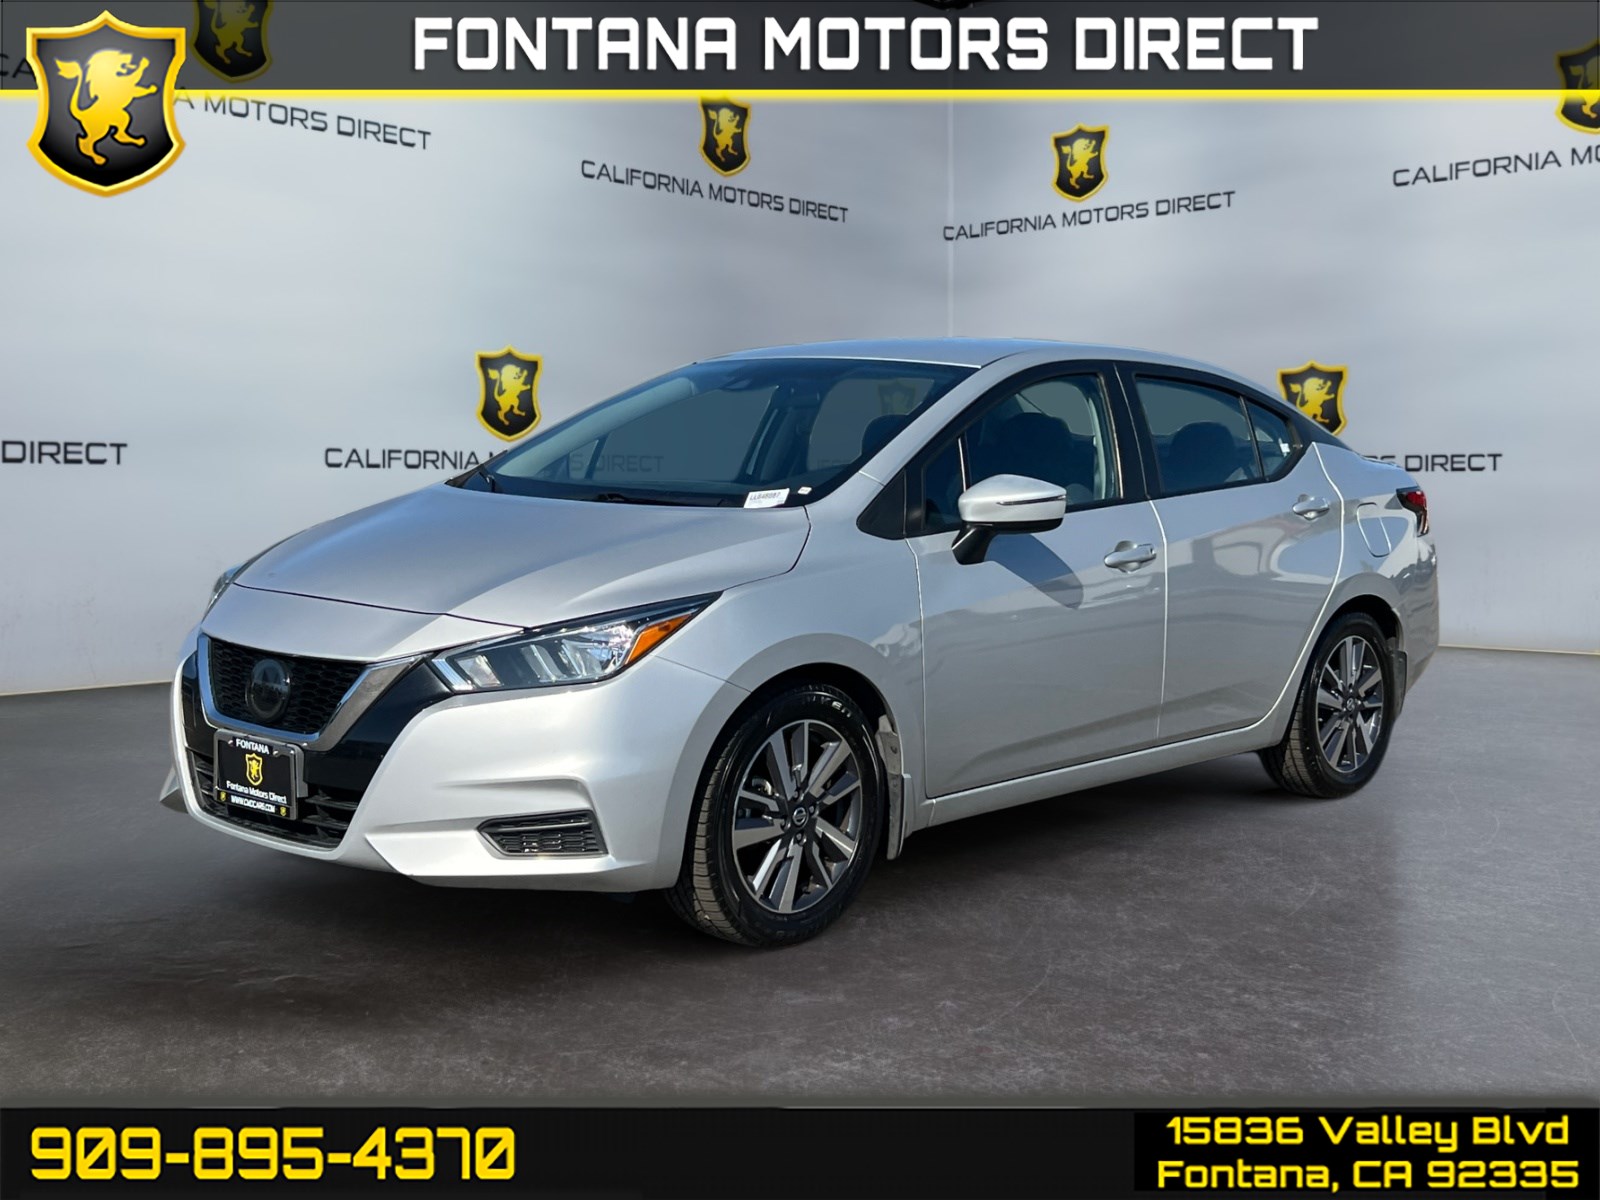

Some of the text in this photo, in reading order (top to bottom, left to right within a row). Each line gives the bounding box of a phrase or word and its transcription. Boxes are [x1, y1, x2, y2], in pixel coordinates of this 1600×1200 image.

[204, 90, 328, 132] MOTORS
[336, 115, 432, 150] DIRECT
[1392, 150, 1562, 188] CALIFORNIA
[581, 159, 849, 224] CALIFORNIA MOTORS DIRECT
[943, 190, 1236, 241] CALIFORNIA MOTORS DIRECT
[1, 440, 128, 465] DIRECT
[324, 447, 480, 470] CALIFORNIA
[1405, 453, 1503, 472] DIRECT
[236, 739, 270, 754] FONTANA
[226, 780, 287, 804] Fontana Motors Direct
